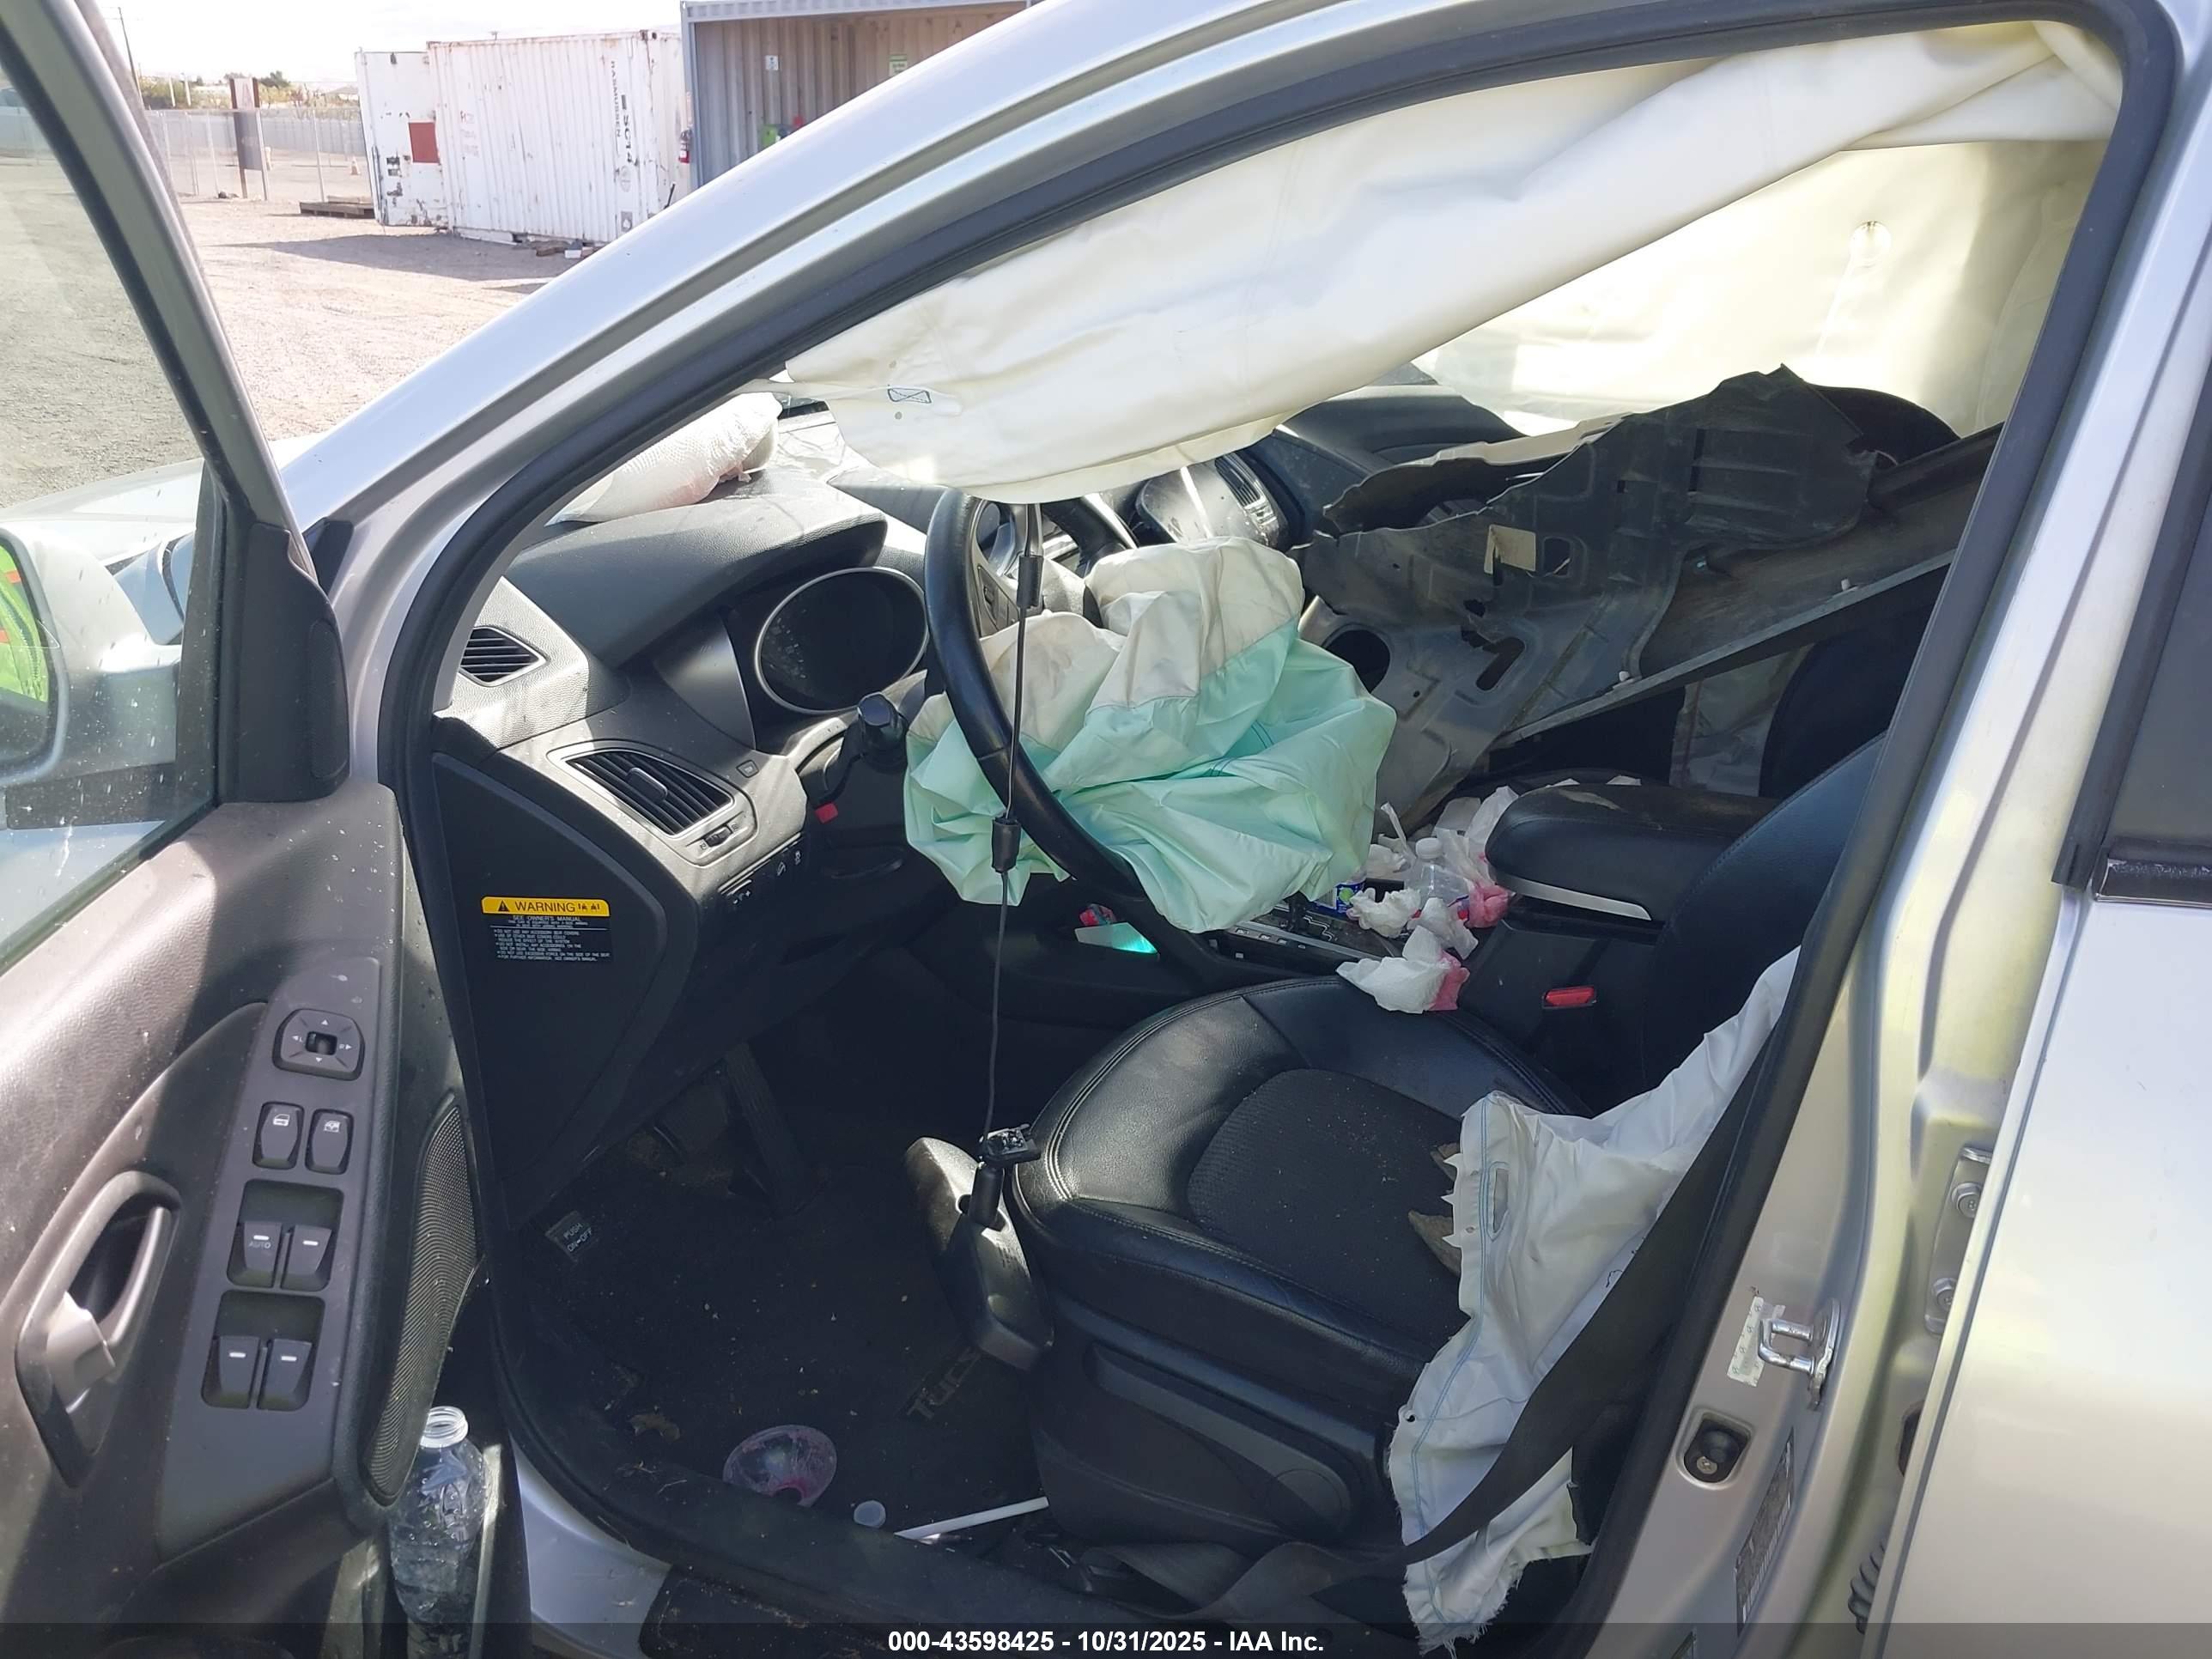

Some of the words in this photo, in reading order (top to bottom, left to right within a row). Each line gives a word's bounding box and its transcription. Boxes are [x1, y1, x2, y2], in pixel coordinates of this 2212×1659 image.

[514, 901, 576, 913] WARNING
[562, 1223, 583, 1240] PUSH
[248, 1241, 271, 1249] AUTO
